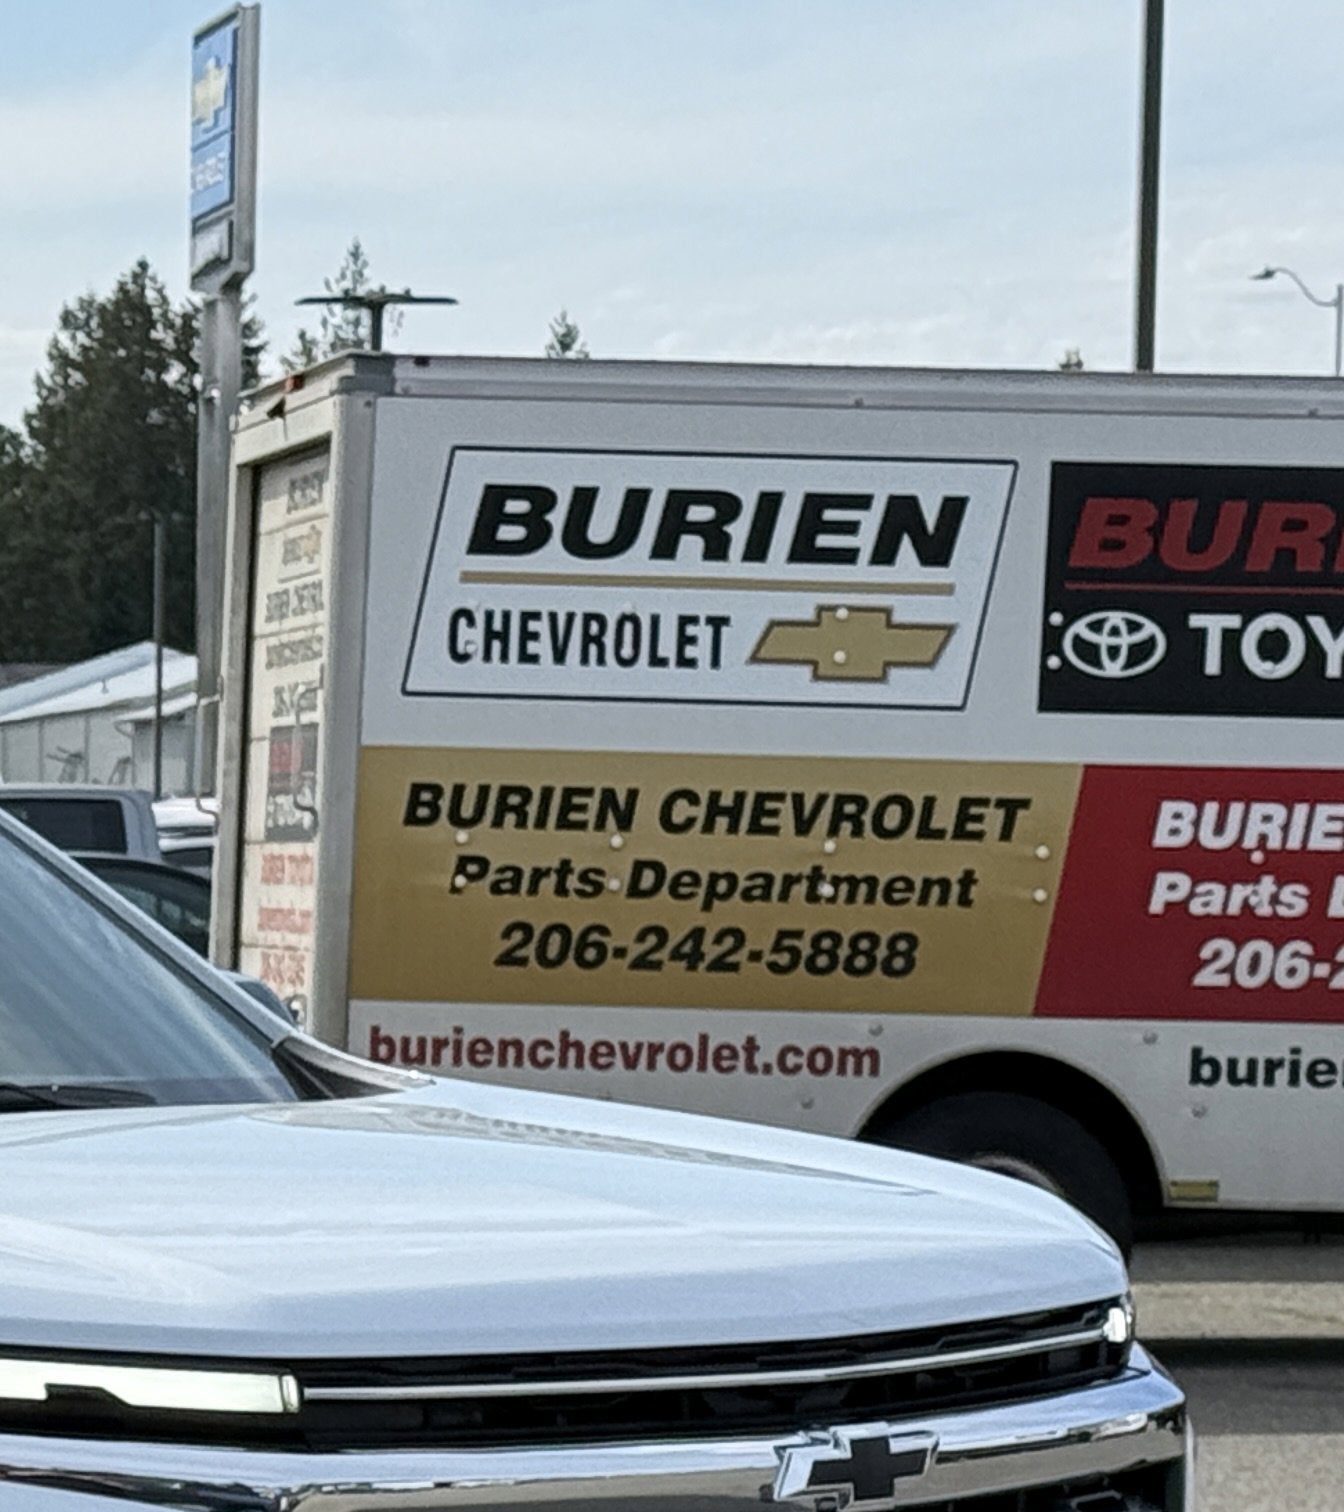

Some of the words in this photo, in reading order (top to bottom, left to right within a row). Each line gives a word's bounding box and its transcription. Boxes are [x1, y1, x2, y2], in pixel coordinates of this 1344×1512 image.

[466, 483, 971, 568] BURIEN
[1067, 496, 1344, 573] BUR
[448, 606, 731, 670] CHEVROLET
[1188, 612, 1344, 680] TOY
[403, 782, 640, 833] BURIEN
[659, 787, 1032, 842] CHEVROLET
[1152, 800, 1344, 851] BURIE
[449, 854, 607, 898] Parts
[626, 857, 979, 912] Department
[1148, 871, 1310, 918] Parts
[495, 921, 919, 978] 206-242-5888
[368, 1025, 881, 1078] burienchevrolet.com
[1189, 1046, 1344, 1089] burie
